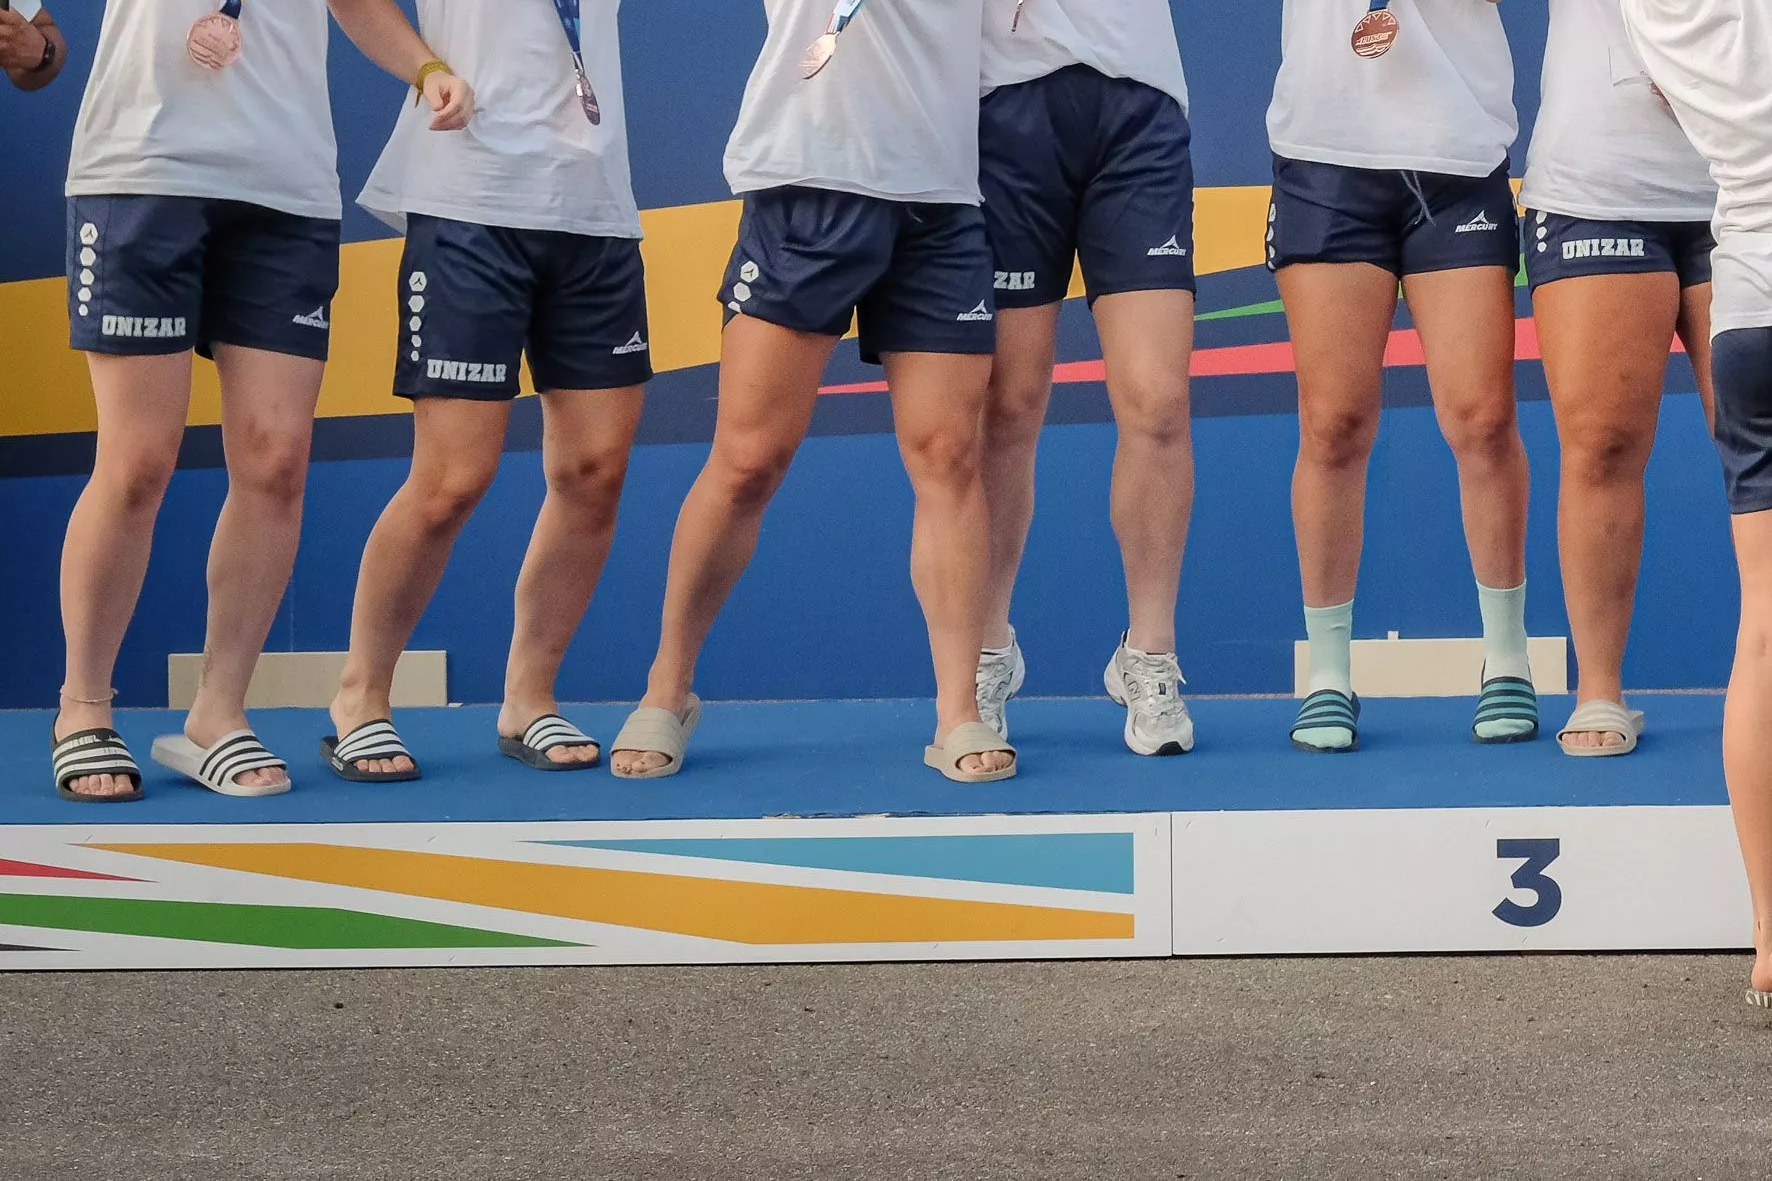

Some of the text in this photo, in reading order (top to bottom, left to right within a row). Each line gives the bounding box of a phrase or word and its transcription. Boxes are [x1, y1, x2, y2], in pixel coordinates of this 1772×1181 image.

[1561, 238, 1645, 260] UNIZAR
[993, 271, 1036, 290] ZAR
[101, 314, 187, 338] UNIZAR
[426, 358, 507, 383] UNIZAR
[1491, 838, 1562, 927] 3
